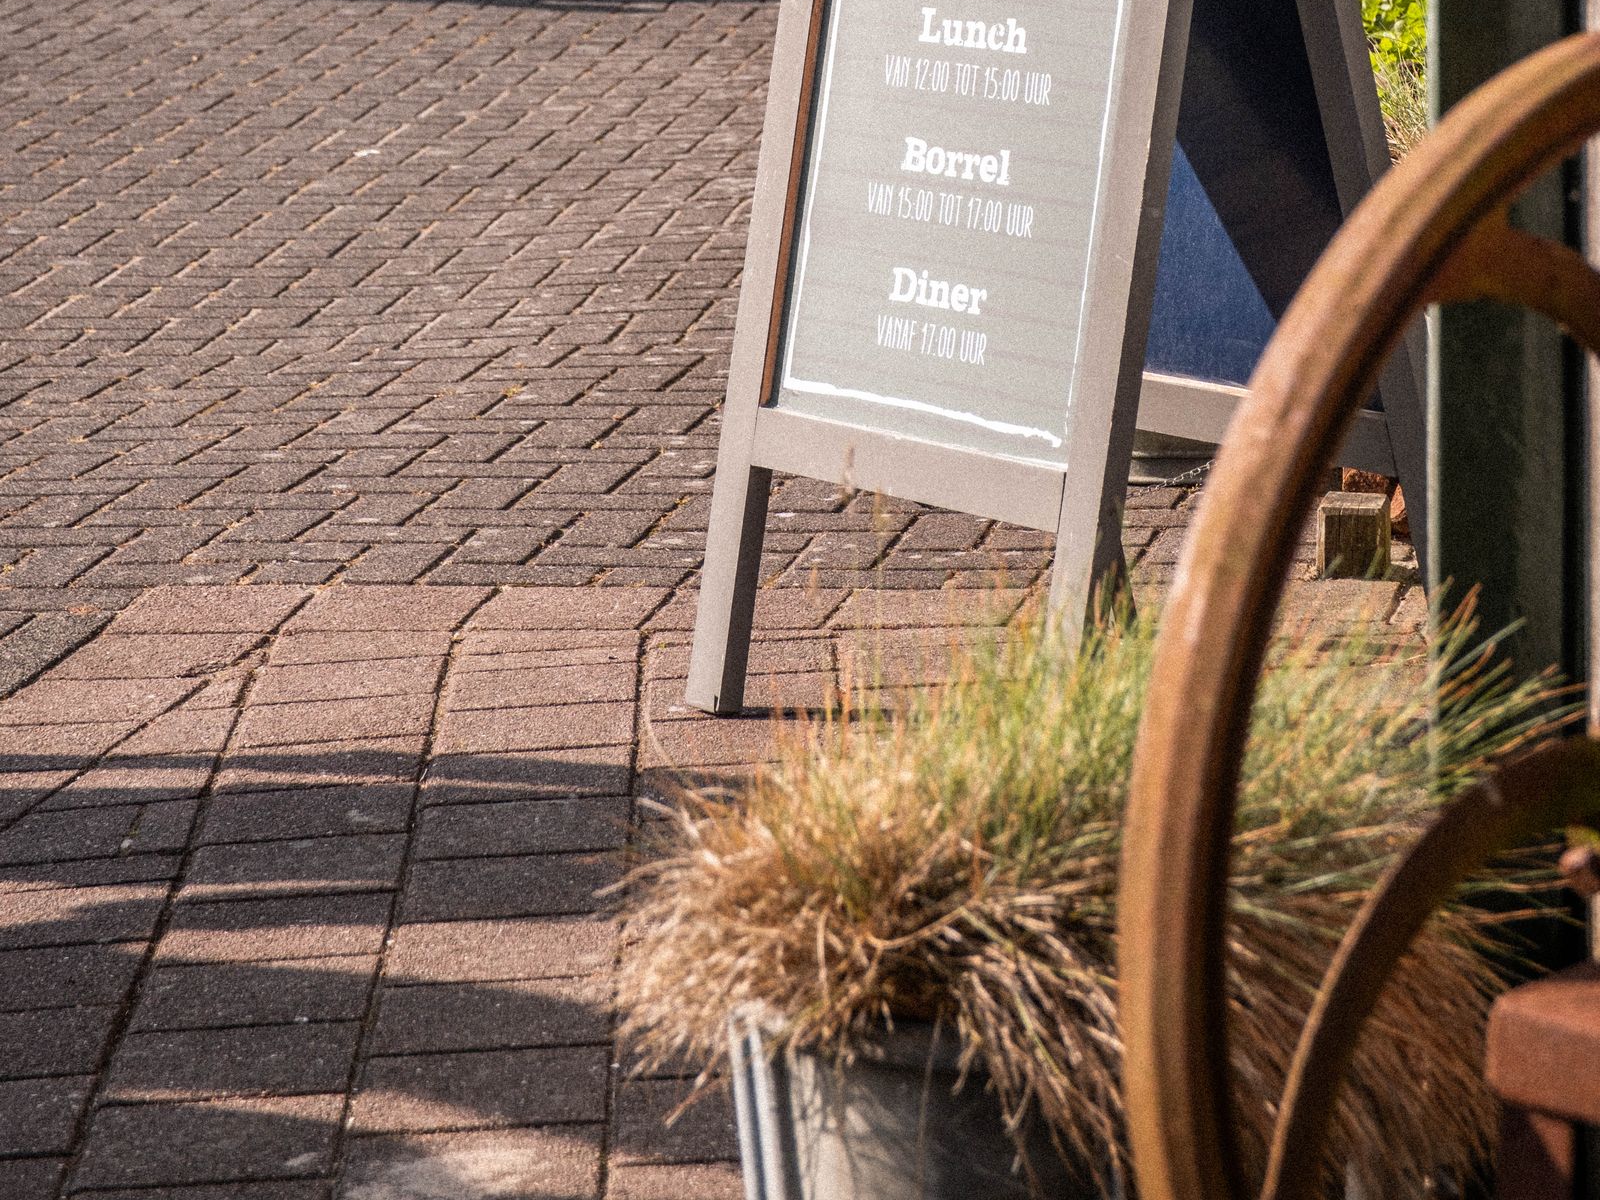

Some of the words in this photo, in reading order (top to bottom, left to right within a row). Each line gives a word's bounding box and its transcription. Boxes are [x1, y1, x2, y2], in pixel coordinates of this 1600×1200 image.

[918, 7, 1027, 54] Lunch
[885, 54, 911, 88] VAN
[915, 58, 949, 92] 12:00
[955, 63, 980, 96] TOT
[984, 67, 1019, 101] 15:00
[1025, 71, 1051, 105] UUR
[901, 136, 1011, 186] Borrel
[868, 182, 894, 216] VAN
[897, 187, 933, 221] 15:00
[939, 192, 963, 226] TOT
[967, 197, 1002, 233] 17:00
[1007, 202, 1034, 238] UUR
[889, 267, 987, 315] Diner
[877, 314, 917, 351] VANAF
[921, 322, 956, 359] 17:00
[960, 329, 987, 366] UUR
